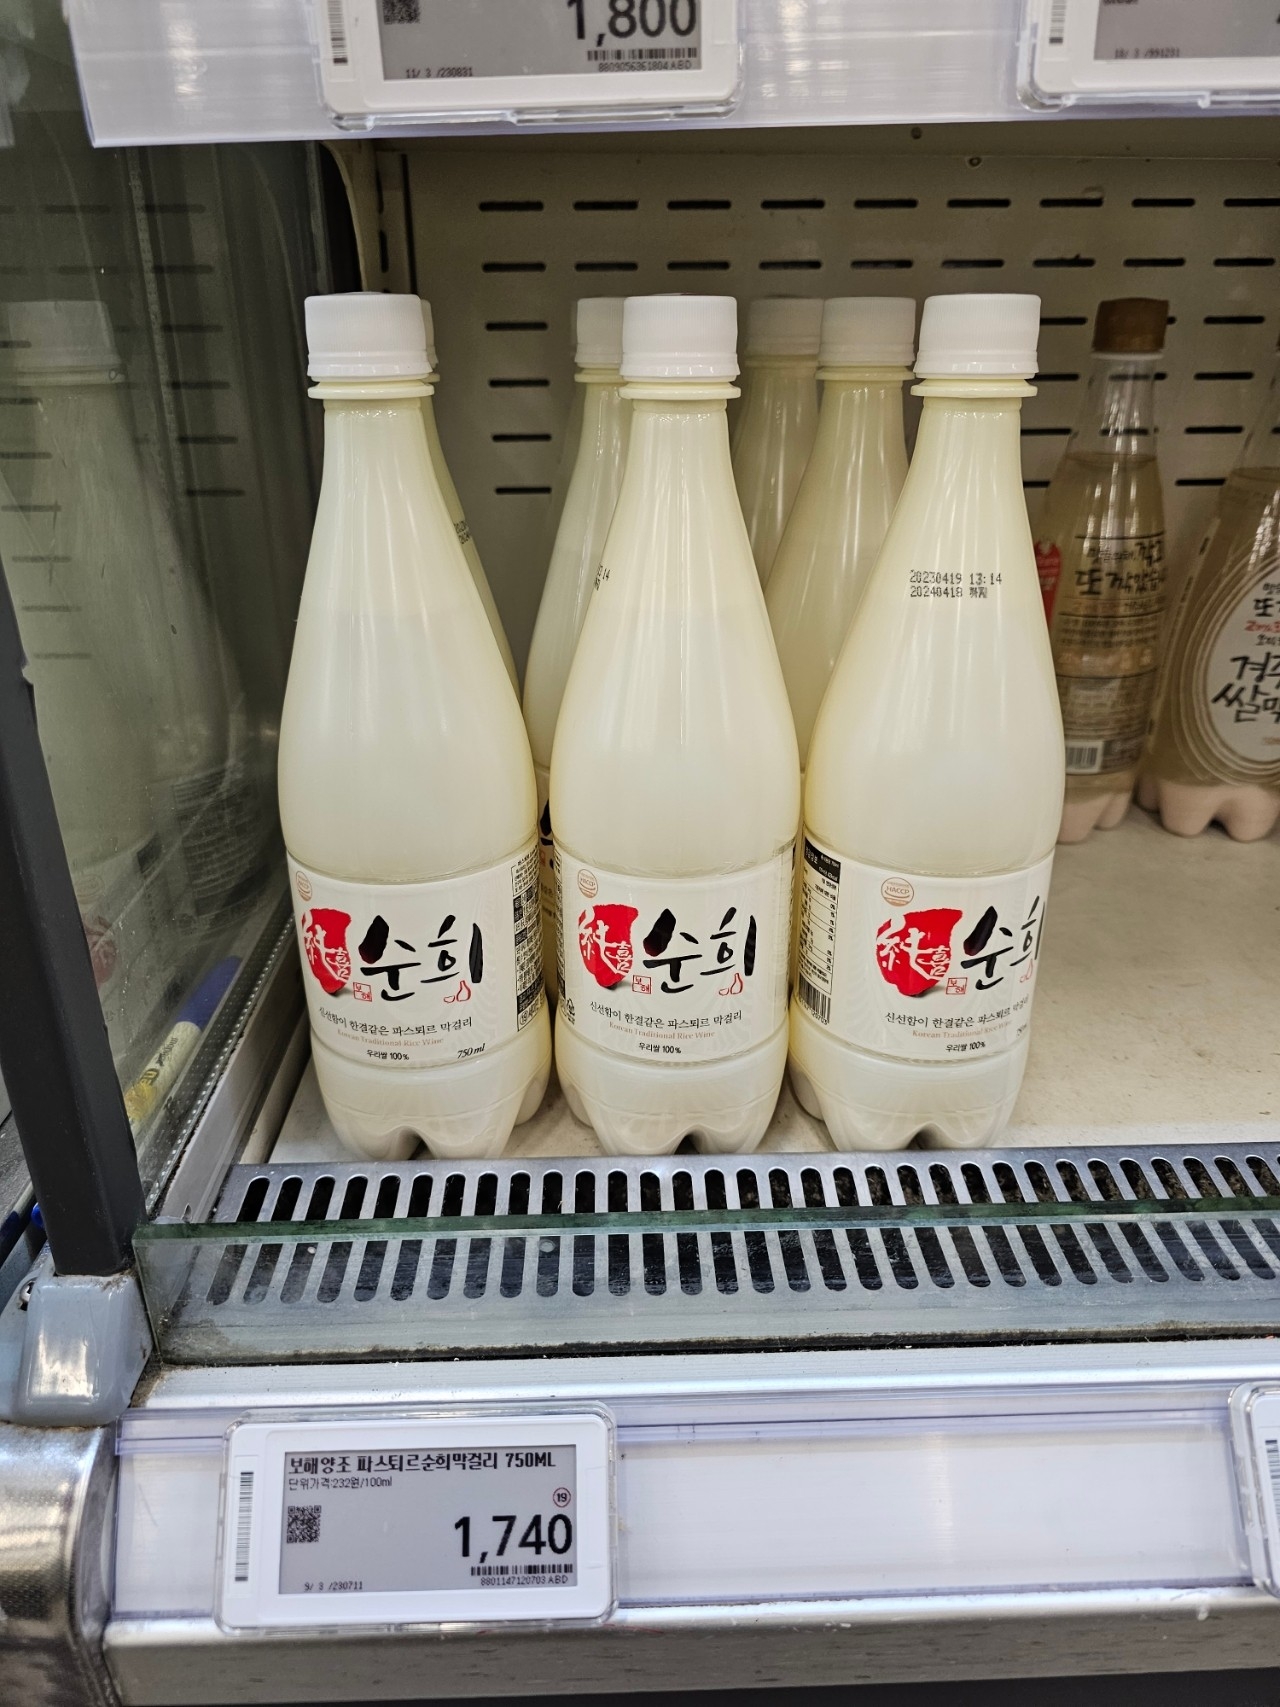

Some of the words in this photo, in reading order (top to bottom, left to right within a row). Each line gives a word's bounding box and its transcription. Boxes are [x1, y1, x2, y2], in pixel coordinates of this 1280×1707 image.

[567, 0, 696, 47] 1,800
[599, 61, 668, 72] 8809056361804
[909, 569, 962, 585] 20230419
[969, 572, 1002, 585] 13:14
[1075, 569, 1101, 595] 또
[910, 585, 963, 598] 20240418
[886, 885, 910, 895] HACCP
[643, 906, 757, 994] 순희
[961, 895, 1046, 991] 순희
[358, 914, 483, 1001] 순희
[589, 1001, 622, 1021] 신선함이
[624, 1013, 665, 1029] 한결같은
[667, 1018, 711, 1030] 파스퇴르
[713, 1010, 743, 1026] 막걸리
[884, 1011, 929, 1028] 신선함이
[932, 1016, 975, 1029] 한결같은
[350, 1020, 389, 1037] 한결같은
[392, 1025, 438, 1037] 파스퇴르
[440, 1016, 473, 1032] 막걸리
[608, 1021, 634, 1034] Korean
[634, 1028, 676, 1040] Traditional
[677, 1032, 694, 1040] Rice
[912, 1029, 941, 1039] Korean
[662, 1045, 682, 1054] 100%
[969, 1040, 986, 1051] 100%
[389, 1050, 410, 1061] 100%
[288, 1456, 352, 1475] 보해양조
[357, 1452, 498, 1473] 파스퇴르순희막걸리
[505, 1452, 556, 1468] 750ML
[288, 1476, 393, 1491] 단위가격:232원/100ml
[454, 1513, 573, 1564] 1,740
[328, 1580, 363, 1591] /230711
[480, 1576, 546, 1586] 8801147120703
[547, 1575, 568, 1585] ABD
